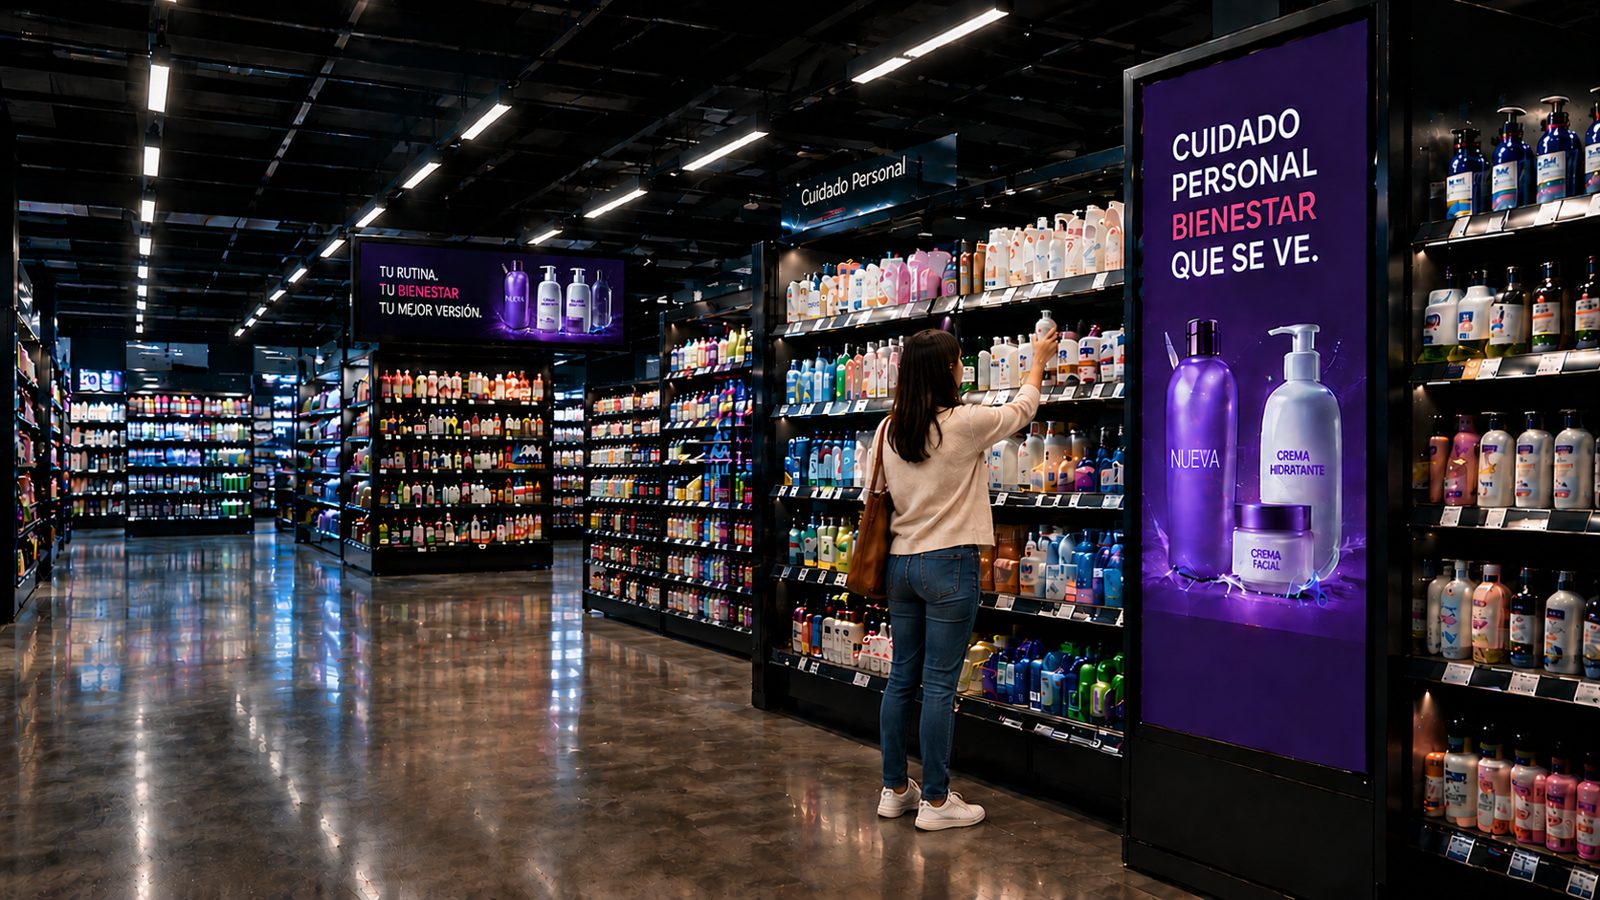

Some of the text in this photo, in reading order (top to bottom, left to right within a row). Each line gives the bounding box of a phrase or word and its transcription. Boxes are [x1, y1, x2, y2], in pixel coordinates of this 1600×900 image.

[1172, 108, 1301, 162] CUIDADO
[801, 154, 906, 206] Cuidado Personal
[1172, 147, 1318, 202] PERSONAL
[1172, 191, 1317, 241] BIENESTAR
[1171, 234, 1319, 280] QUE SE VE.
[379, 265, 439, 281] TU RUTINA.
[379, 283, 460, 300] TU BIENESTAR
[379, 301, 482, 319] TU MEJOR VERSIÓN.
[1171, 449, 1220, 469] NUEVA
[1276, 450, 1310, 462] CREMA
[1269, 464, 1326, 476] HIDRATANTE
[1250, 548, 1282, 561] CREMA
[1252, 559, 1281, 571] FACIAL
